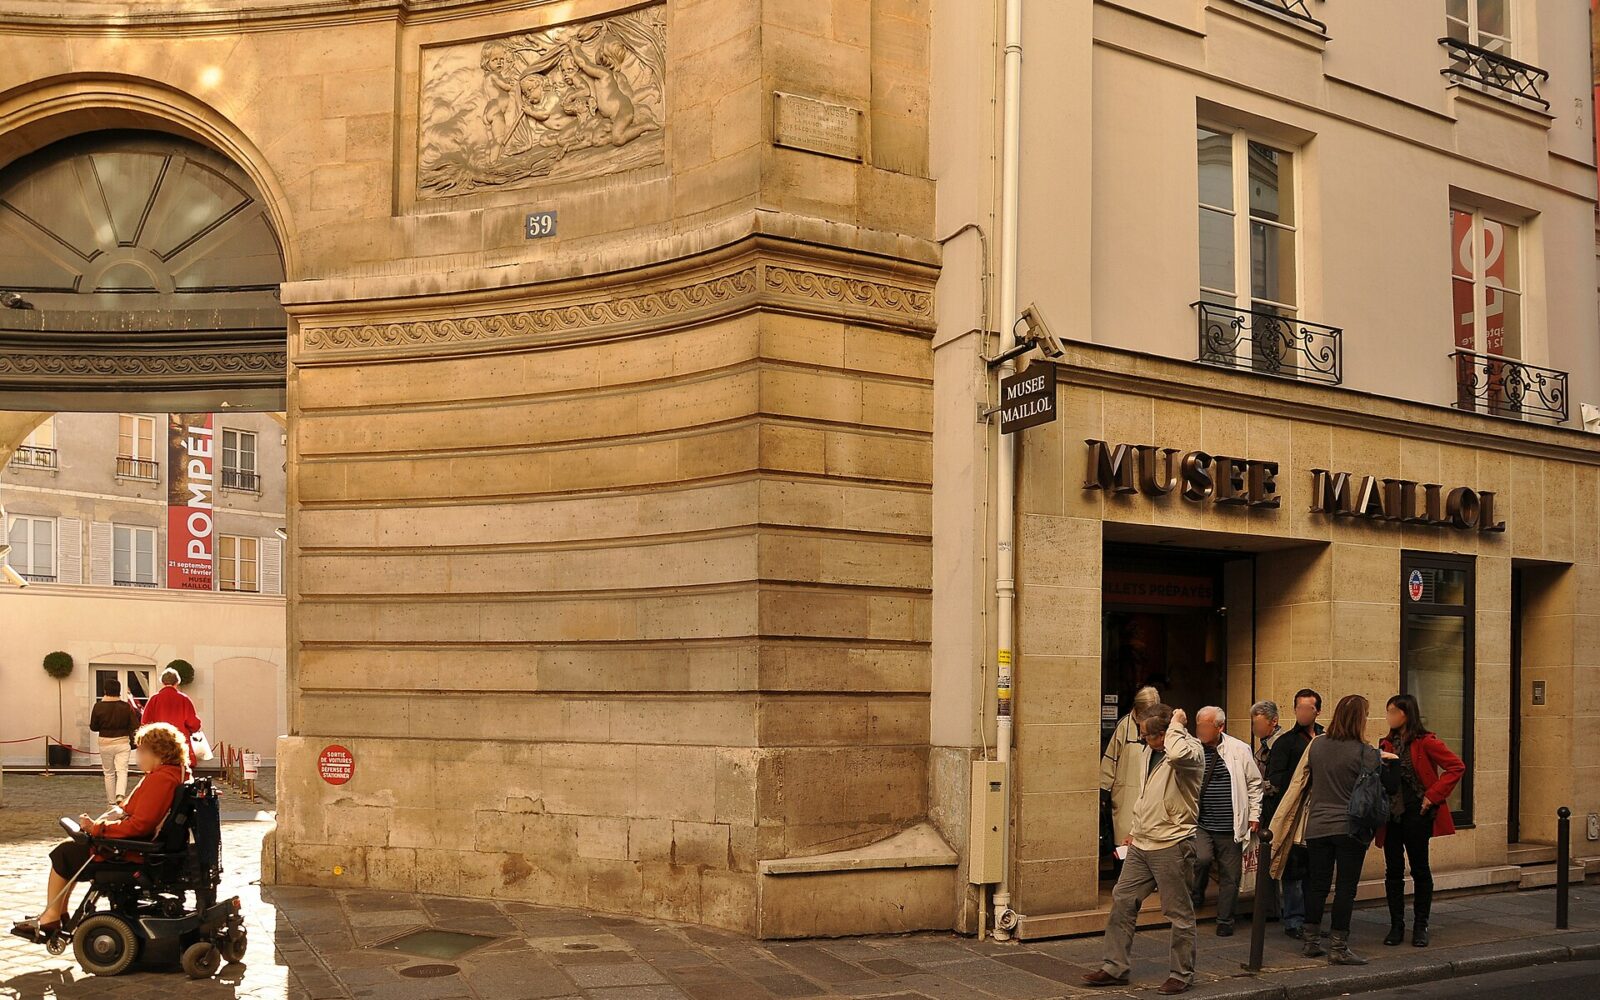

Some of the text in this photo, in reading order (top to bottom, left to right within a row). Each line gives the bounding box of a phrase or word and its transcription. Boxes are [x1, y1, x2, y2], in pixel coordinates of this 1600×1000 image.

[530, 215, 552, 236] 59
[1002, 396, 1052, 424] MAILLOL
[1007, 375, 1045, 400] MUSEE
[181, 426, 212, 560] POMPÉI
[1081, 438, 1281, 509] MUSEE
[1308, 468, 1506, 533] MAILLOL
